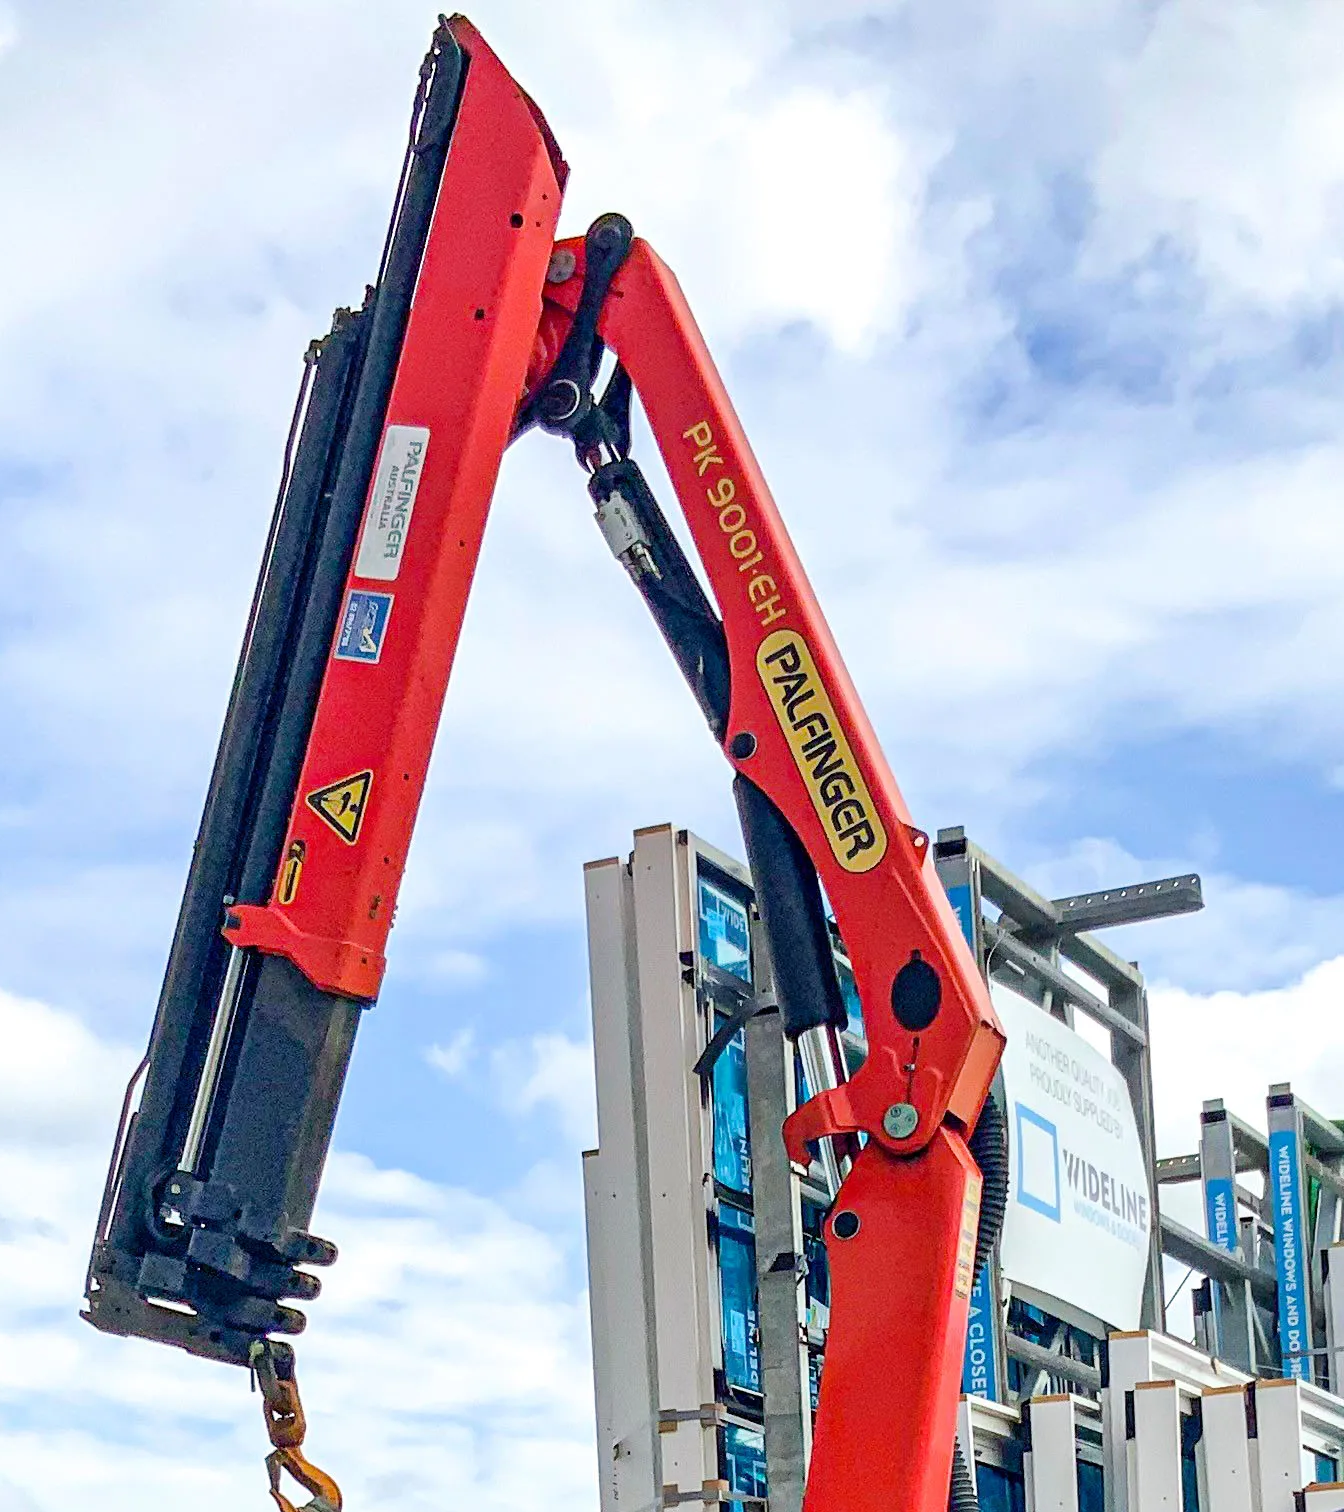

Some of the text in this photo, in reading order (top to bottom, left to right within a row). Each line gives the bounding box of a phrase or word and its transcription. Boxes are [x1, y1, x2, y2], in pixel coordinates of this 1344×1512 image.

[682, 420, 724, 478] PK
[378, 465, 399, 530] AUSTRALIA
[384, 441, 423, 559] PALFINGER
[763, 642, 875, 861] PALFINGER
[1025, 1030, 1069, 1073] ANOTHER
[1070, 1058, 1105, 1097] QUALITY
[1029, 1062, 1072, 1107] PROUDLY
[1073, 1089, 1115, 1136] SUPPLIED
[1063, 1148, 1148, 1234] WIDELINE
[1278, 1145, 1293, 1214] WIDELINE
[1279, 1219, 1297, 1292] WINDOWS
[1286, 1296, 1301, 1327] AND
